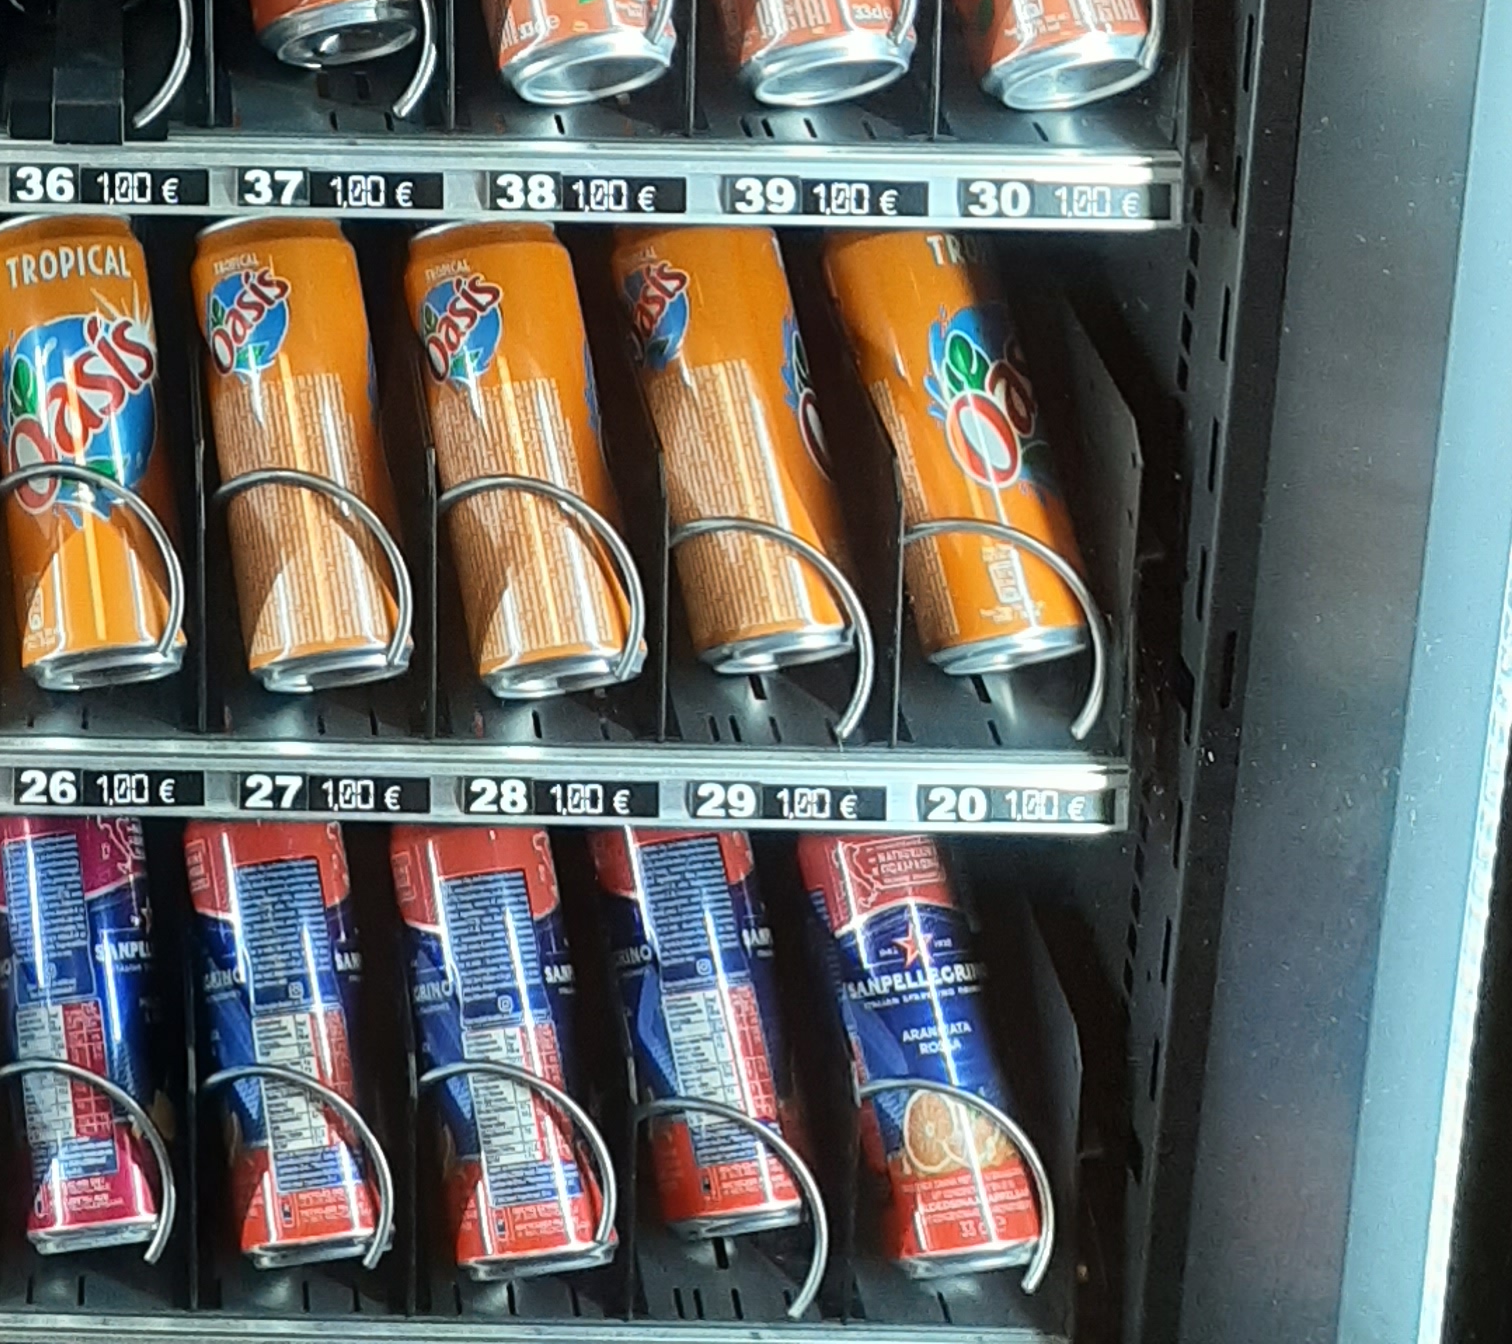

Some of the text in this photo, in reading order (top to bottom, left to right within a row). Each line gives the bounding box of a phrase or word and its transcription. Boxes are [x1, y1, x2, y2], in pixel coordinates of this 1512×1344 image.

[15, 166, 76, 201] 36
[244, 170, 305, 205] 37
[330, 173, 414, 208] 1,00 €
[495, 174, 557, 209] 38
[734, 178, 797, 212] 39
[967, 182, 1029, 216] 30
[6, 244, 131, 287] TROPICAL
[211, 265, 292, 376] Oasis
[424, 272, 504, 383] Oasis
[8, 315, 158, 514] Oasis
[19, 771, 77, 804] 26
[97, 773, 176, 806] 1,00 €
[244, 775, 303, 809] 27
[470, 779, 528, 813] 28
[697, 784, 757, 818] 29
[927, 787, 986, 822] 20
